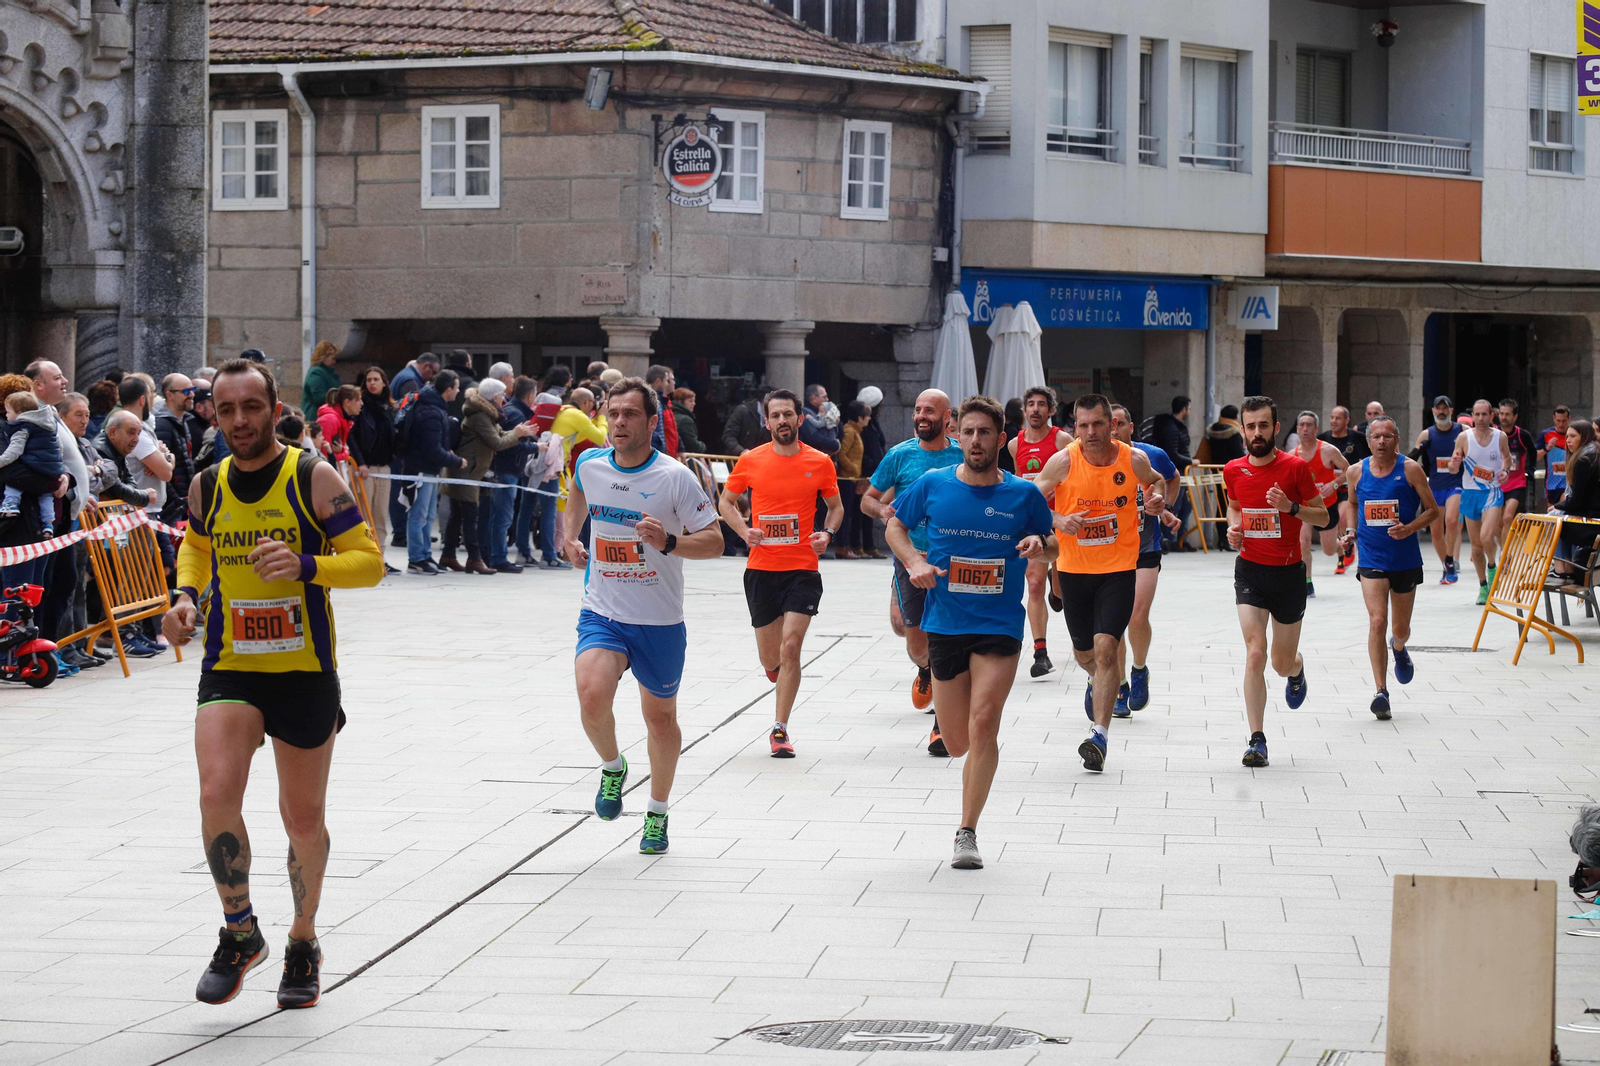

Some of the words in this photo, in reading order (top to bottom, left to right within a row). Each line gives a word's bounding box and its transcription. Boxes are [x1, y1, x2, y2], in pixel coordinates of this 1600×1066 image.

[673, 147, 711, 160] Estrella
[675, 160, 710, 173] Galicia
[674, 195, 682, 205] LA
[683, 197, 703, 207] CUEVA
[1051, 286, 1122, 301] PERFUMERÍA
[1051, 306, 1121, 322] COSMÉTICA
[1077, 498, 1114, 507] Domus
[1371, 507, 1389, 520] 653
[766, 523, 787, 538] 789
[1249, 517, 1269, 531] 260
[214, 527, 297, 549] TANINOS
[937, 527, 1011, 541] www.empuxe.es
[1084, 525, 1107, 540] 239
[605, 546, 627, 563] 105
[958, 568, 991, 585] 1067
[245, 616, 282, 640] 690
